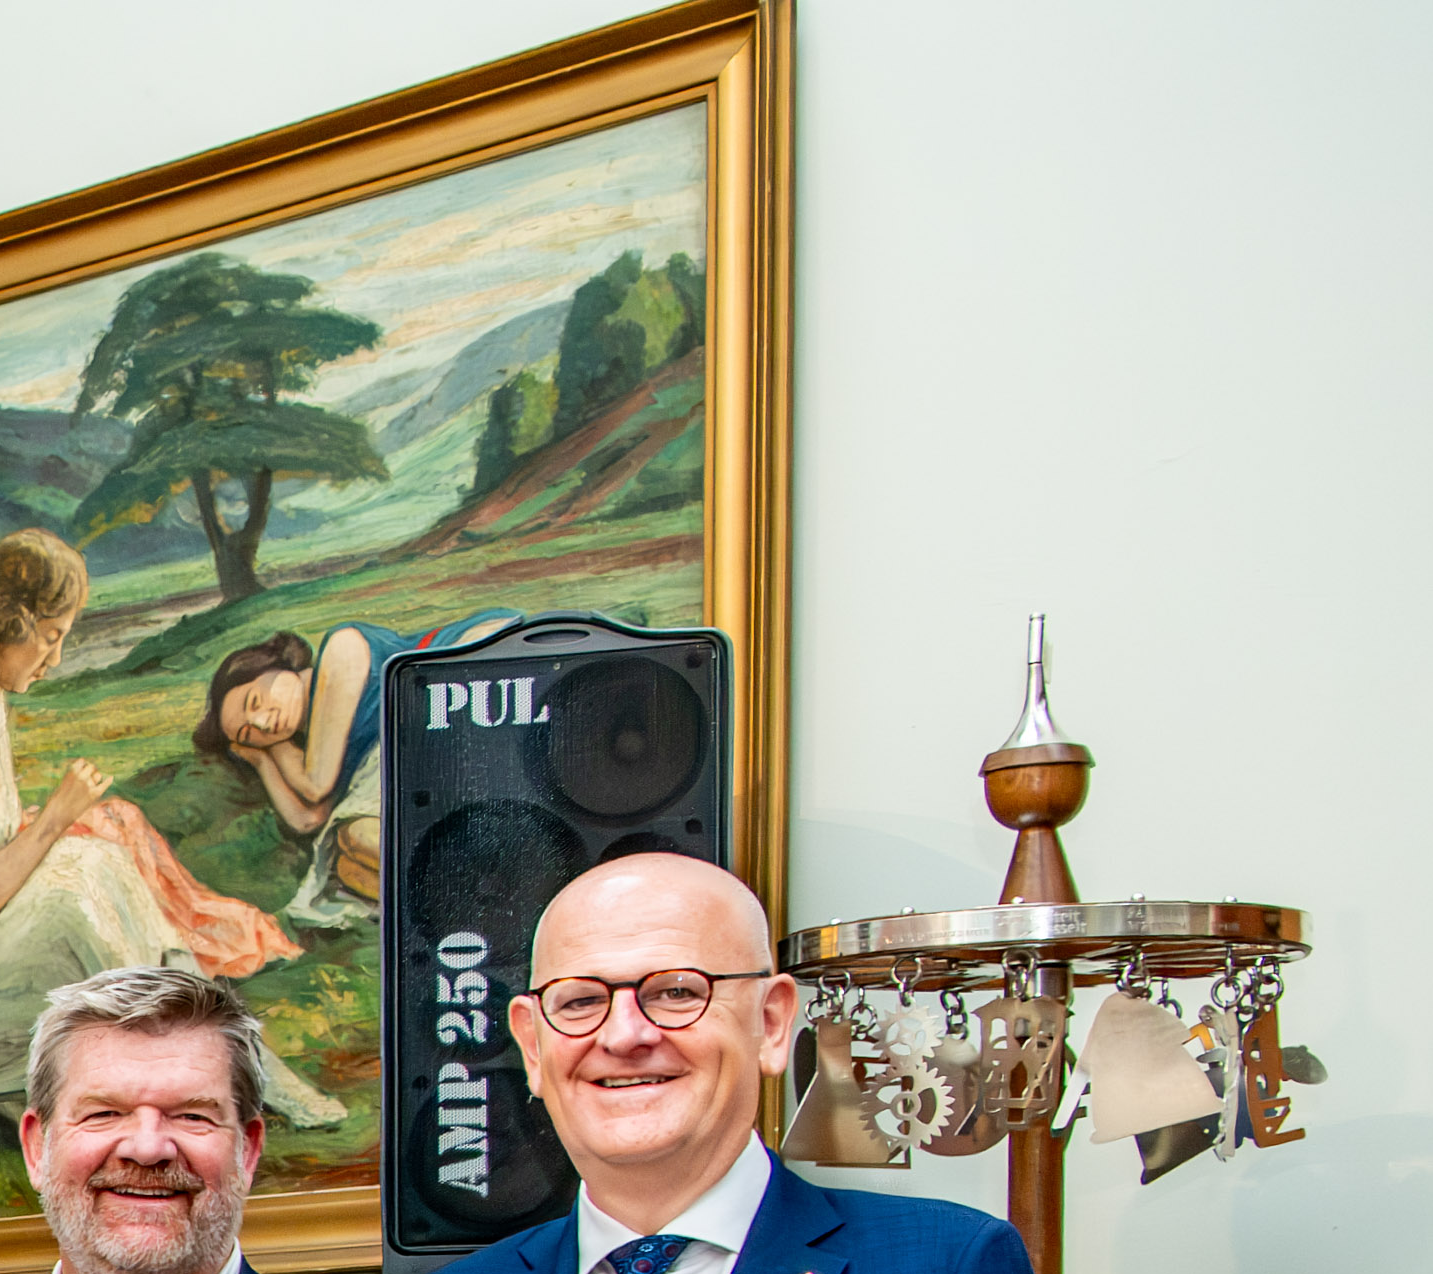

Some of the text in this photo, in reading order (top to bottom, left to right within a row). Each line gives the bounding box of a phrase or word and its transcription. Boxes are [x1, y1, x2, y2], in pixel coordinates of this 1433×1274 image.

[425, 676, 551, 731] PUL
[436, 931, 489, 1198] AMP 250
